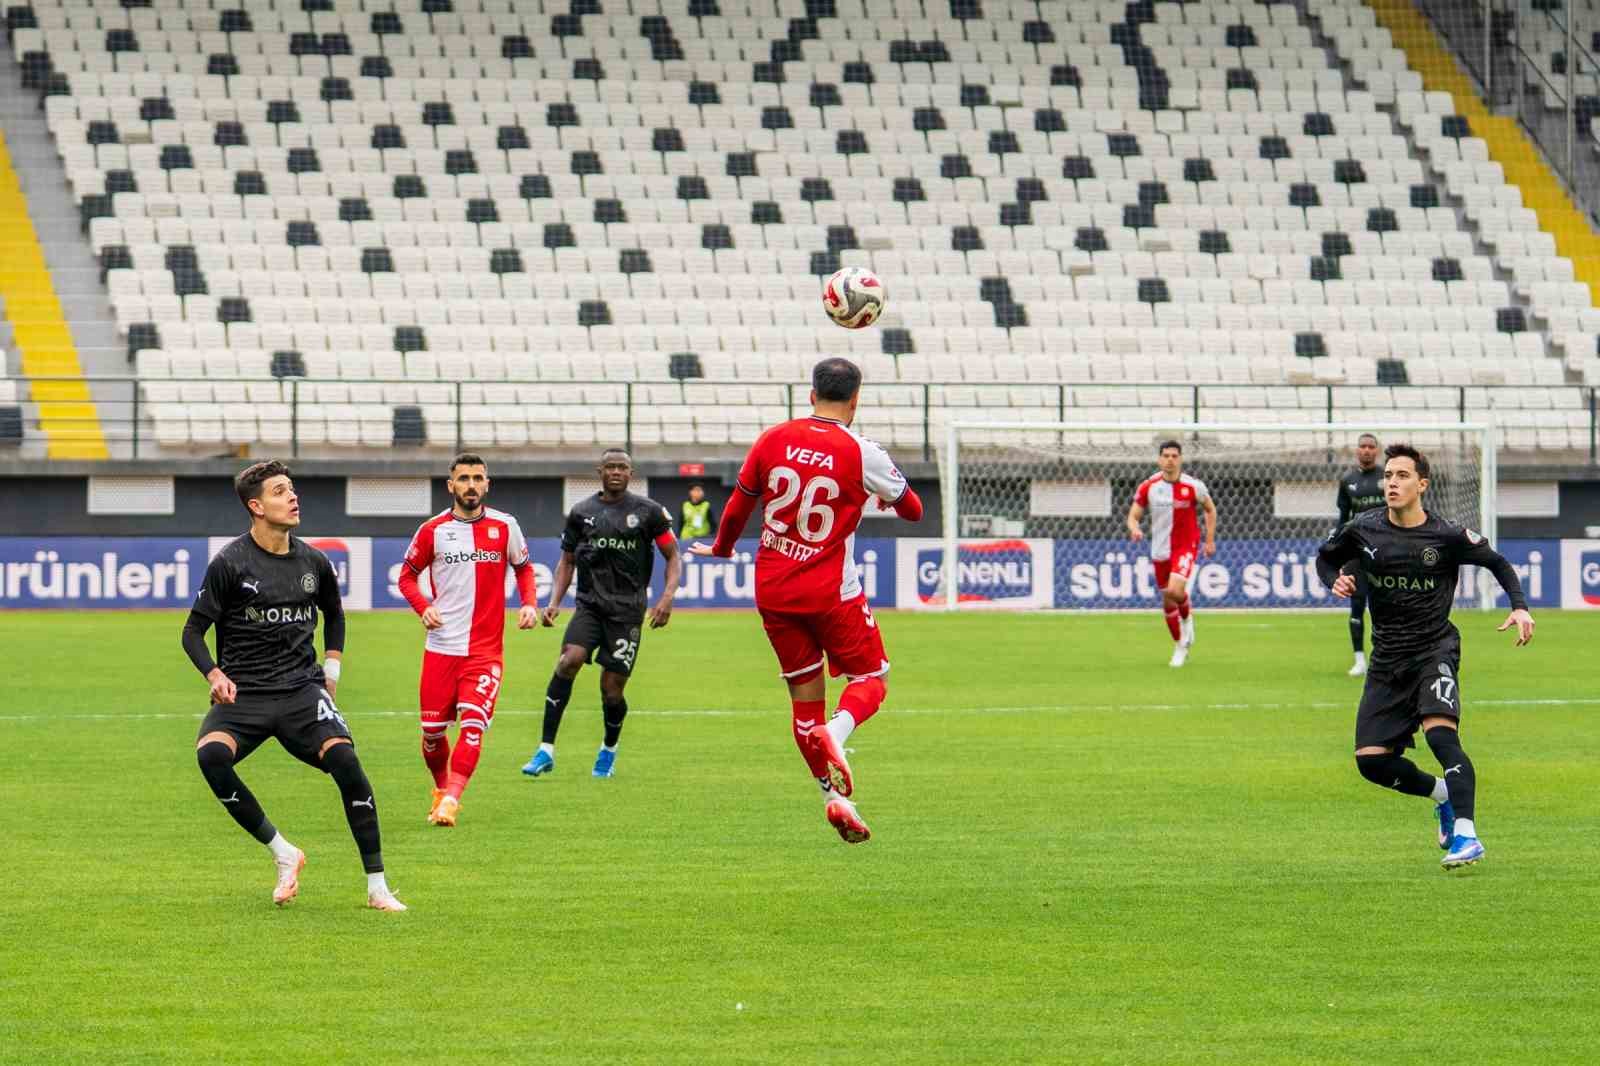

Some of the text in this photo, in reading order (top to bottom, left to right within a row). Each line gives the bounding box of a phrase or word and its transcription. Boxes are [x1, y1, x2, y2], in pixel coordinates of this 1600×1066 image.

[785, 445, 834, 471] VEFA
[764, 466, 840, 543] 26
[0, 550, 190, 599] rünleri
[1070, 552, 1155, 599] süt
[1242, 552, 1327, 599] süt
[612, 638, 637, 661] 25
[475, 674, 500, 700] 27
[1430, 676, 1455, 700] 17
